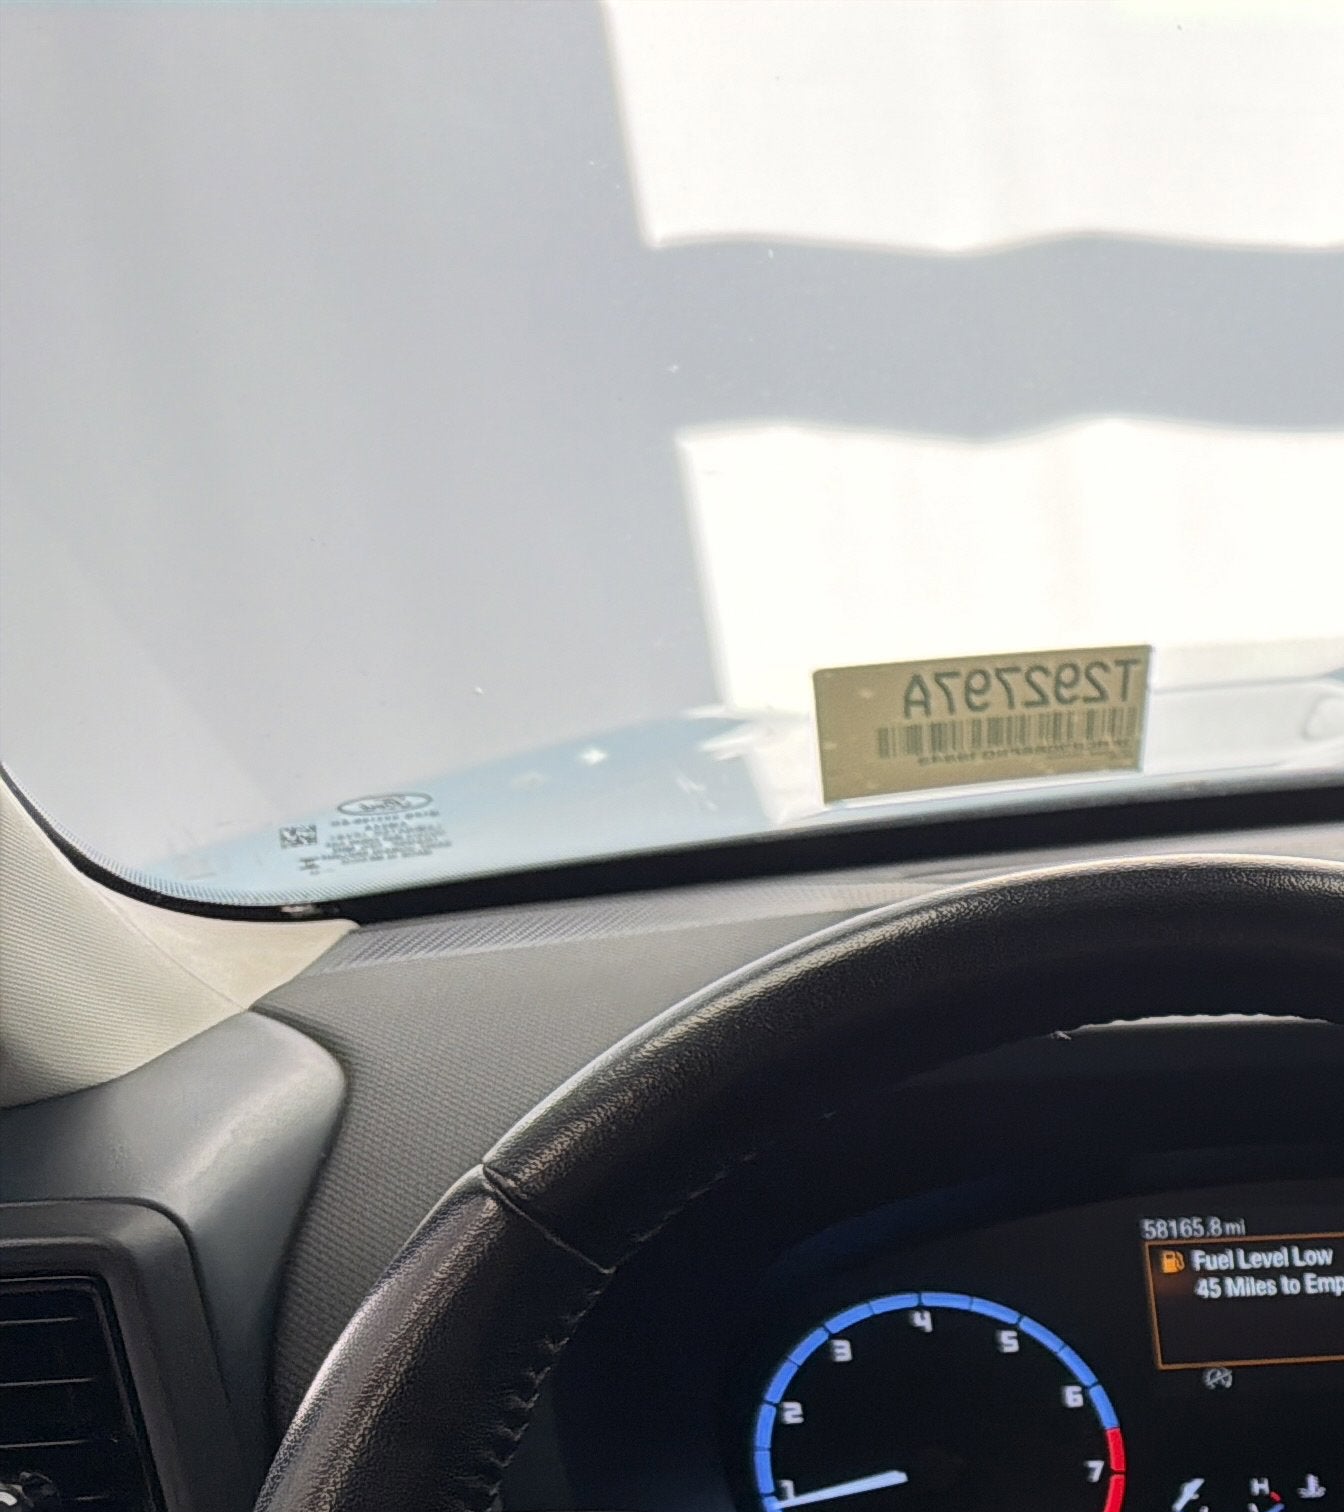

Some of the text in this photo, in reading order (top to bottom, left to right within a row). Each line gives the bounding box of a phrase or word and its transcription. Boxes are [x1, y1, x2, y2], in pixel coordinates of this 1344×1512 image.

[1191, 1246, 1334, 1272] Fuel Level Low
[1195, 1277, 1222, 1300] 45
[1224, 1275, 1278, 1298] Miles
[1280, 1275, 1301, 1295] to
[910, 1310, 932, 1332] 4
[831, 1339, 852, 1362] 3
[998, 1330, 1019, 1353] 5
[1063, 1385, 1083, 1408] 6
[782, 1401, 803, 1424] 2
[1085, 1460, 1104, 1483] 7
[779, 1480, 795, 1500] 1
[1251, 1477, 1269, 1496] H
